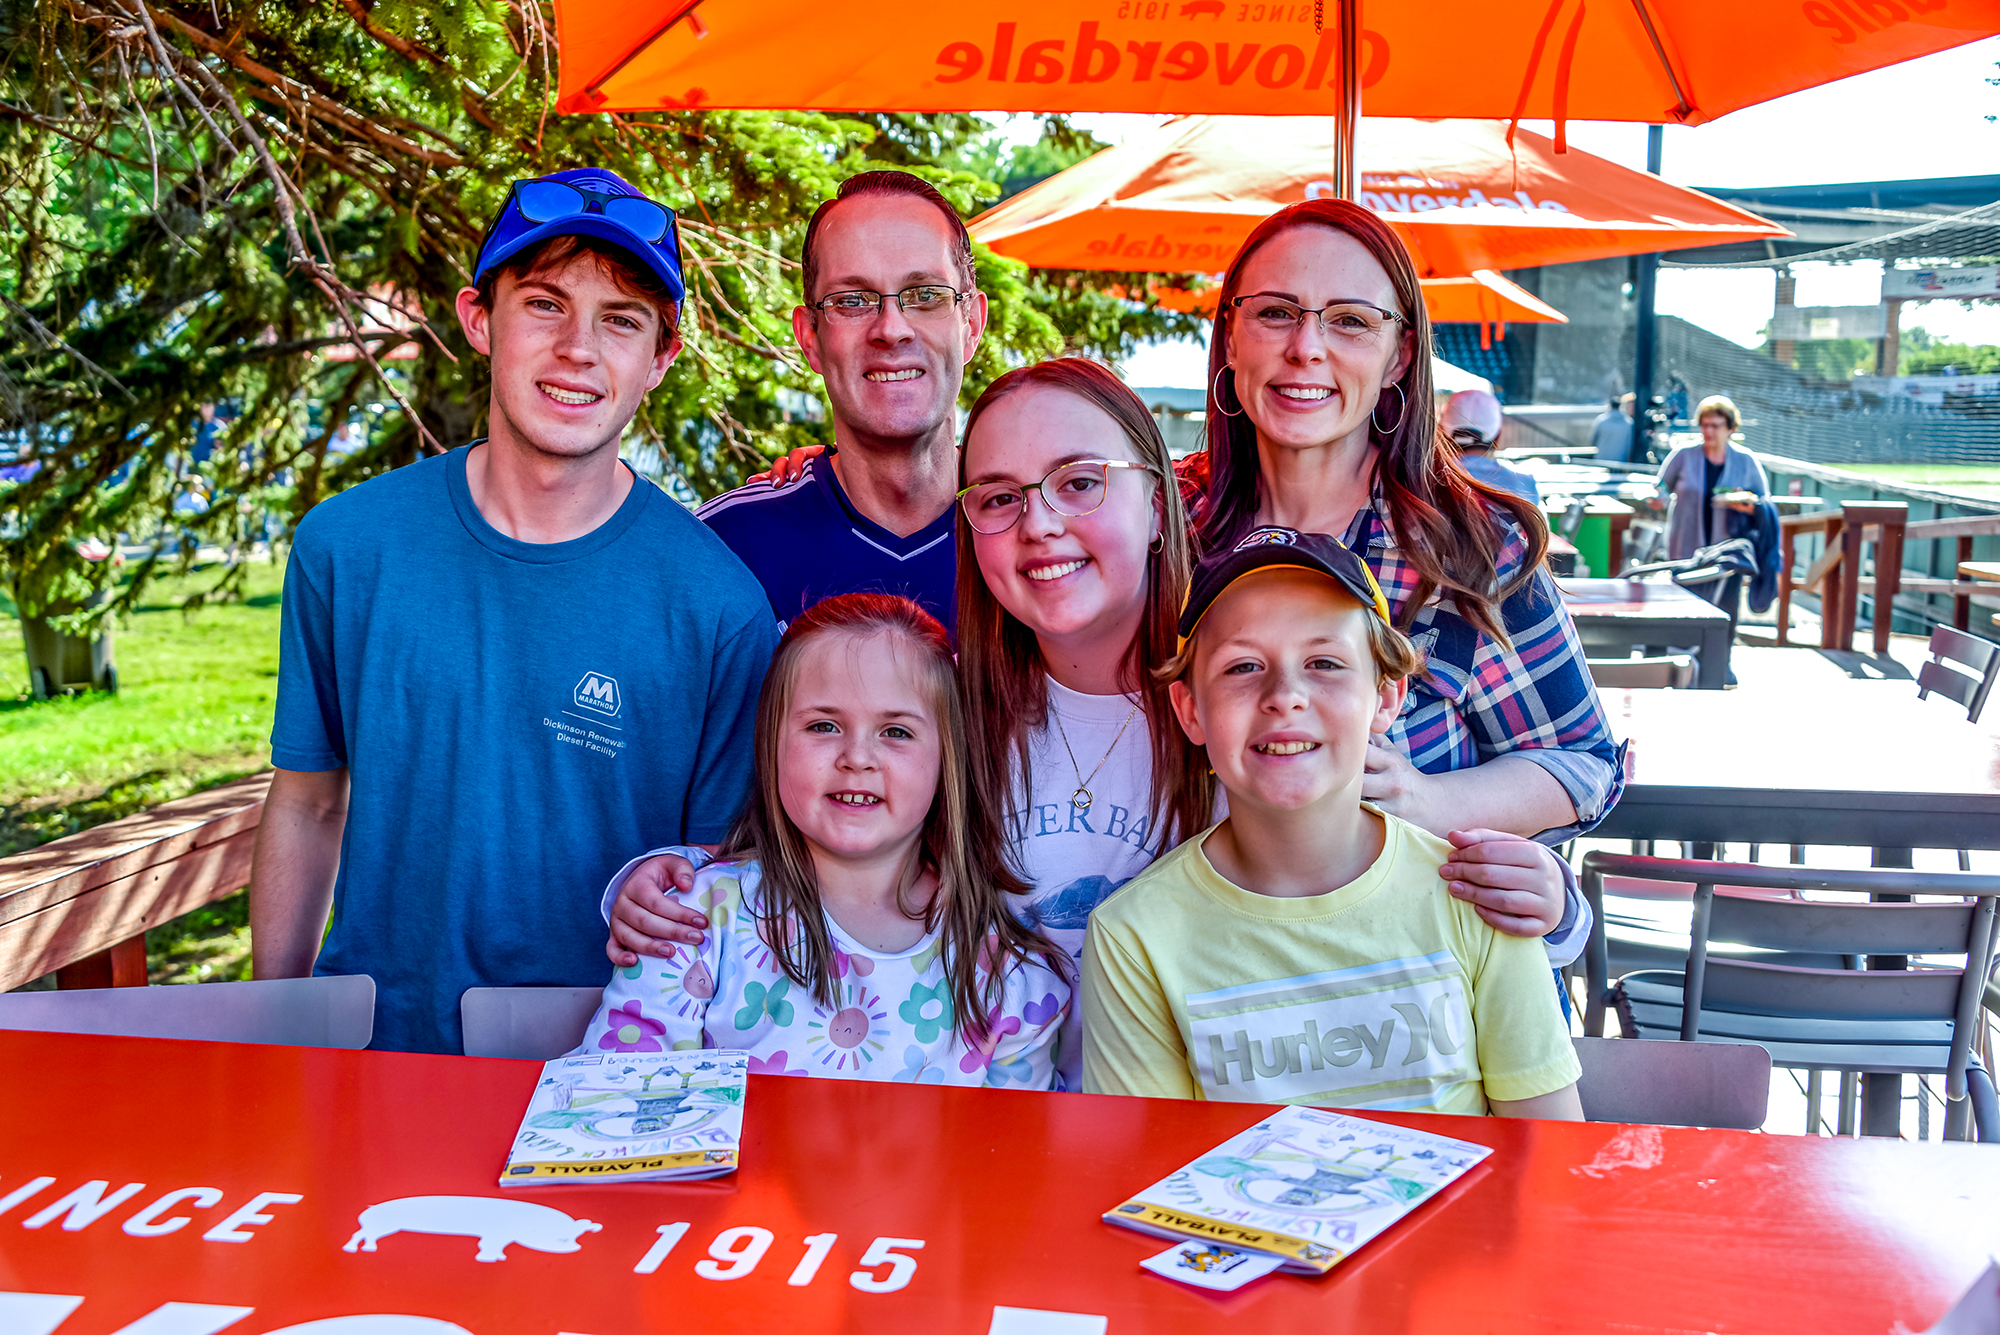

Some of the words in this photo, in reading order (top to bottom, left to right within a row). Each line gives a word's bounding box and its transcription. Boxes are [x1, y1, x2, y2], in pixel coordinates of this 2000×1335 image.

[577, 695, 614, 711] MARATHON
[581, 677, 613, 703] M
[543, 717, 586, 736] Dickinson
[556, 732, 584, 746] Diesel
[585, 741, 617, 758] Facility
[1103, 804, 1165, 858] BA
[1208, 1019, 1396, 1086] Hurley
[544, 1159, 664, 1174] PLAYBALL
[0, 1176, 304, 1244] INCE
[633, 1221, 926, 1294] 1915
[1151, 1210, 1263, 1243] PLAYBALL
